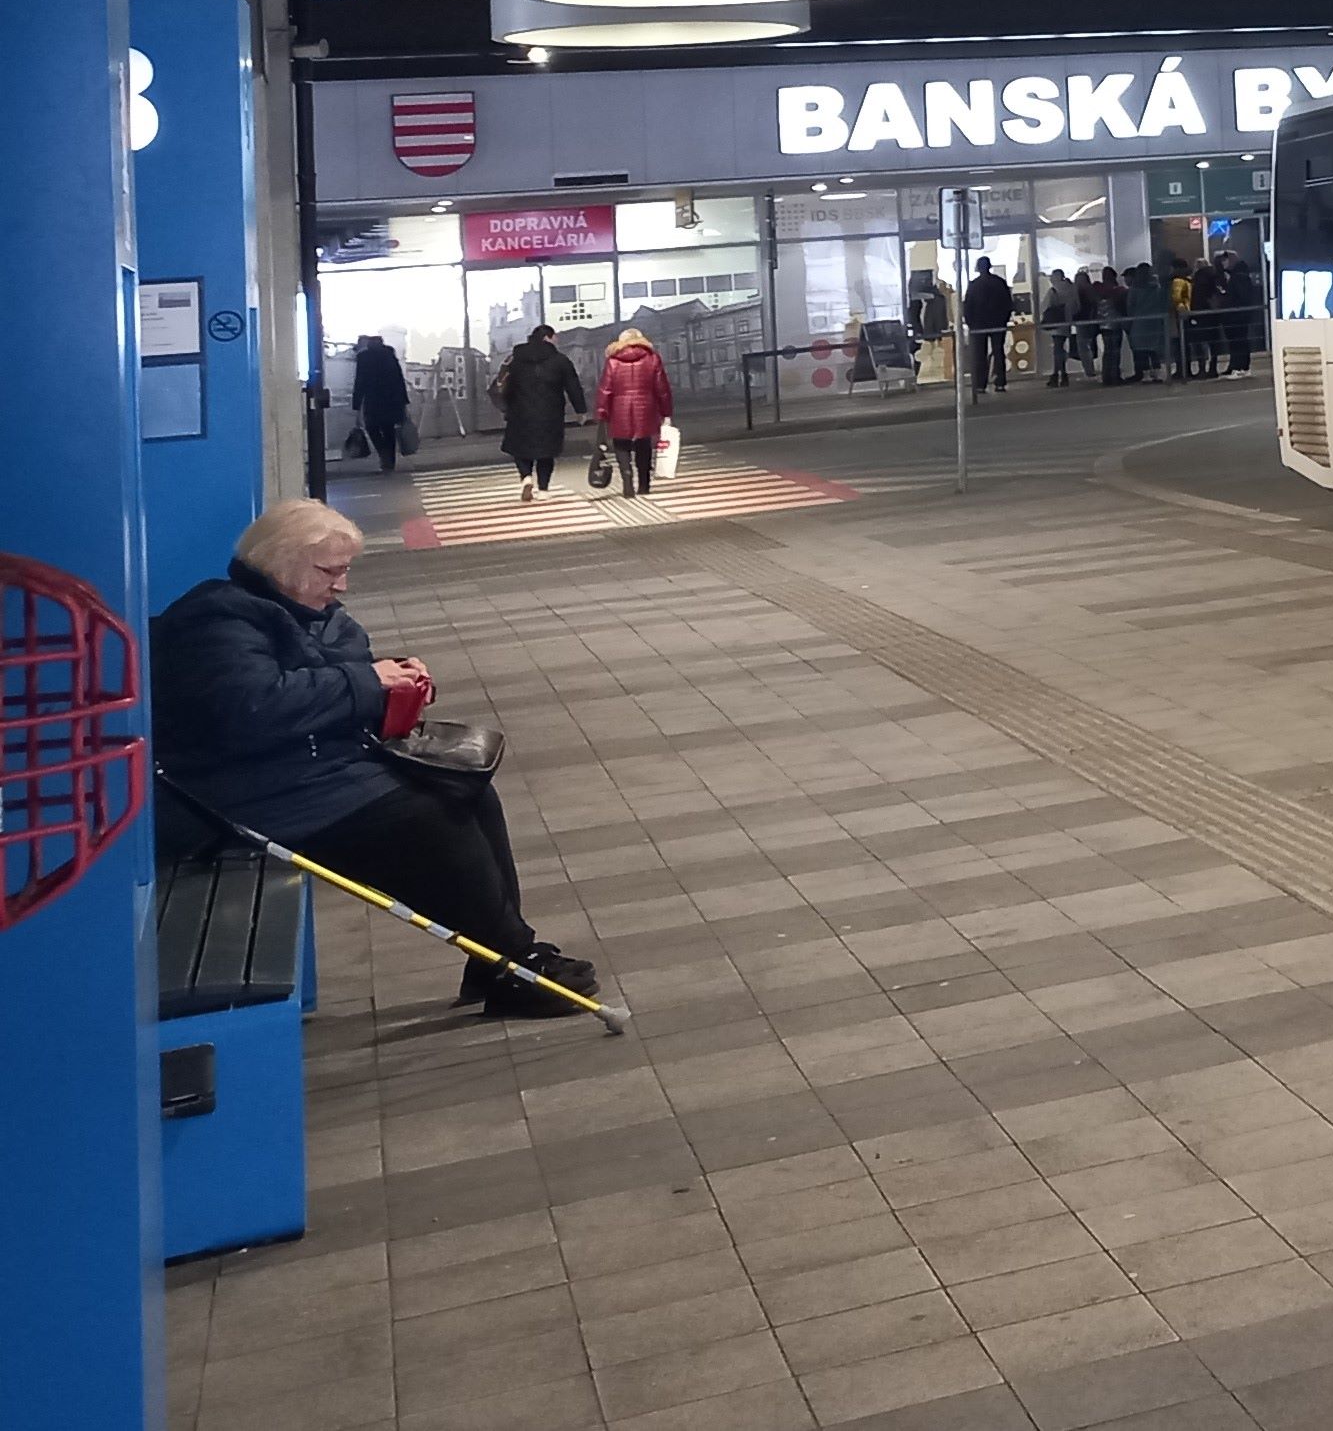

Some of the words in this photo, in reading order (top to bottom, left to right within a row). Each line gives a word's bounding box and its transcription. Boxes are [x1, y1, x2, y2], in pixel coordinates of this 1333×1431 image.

[778, 56, 1206, 154] BANSKÁ
[490, 211, 587, 233] DOPRAVNÁ
[811, 208, 838, 222] IDS
[481, 232, 596, 252] KANCELÁRIA
